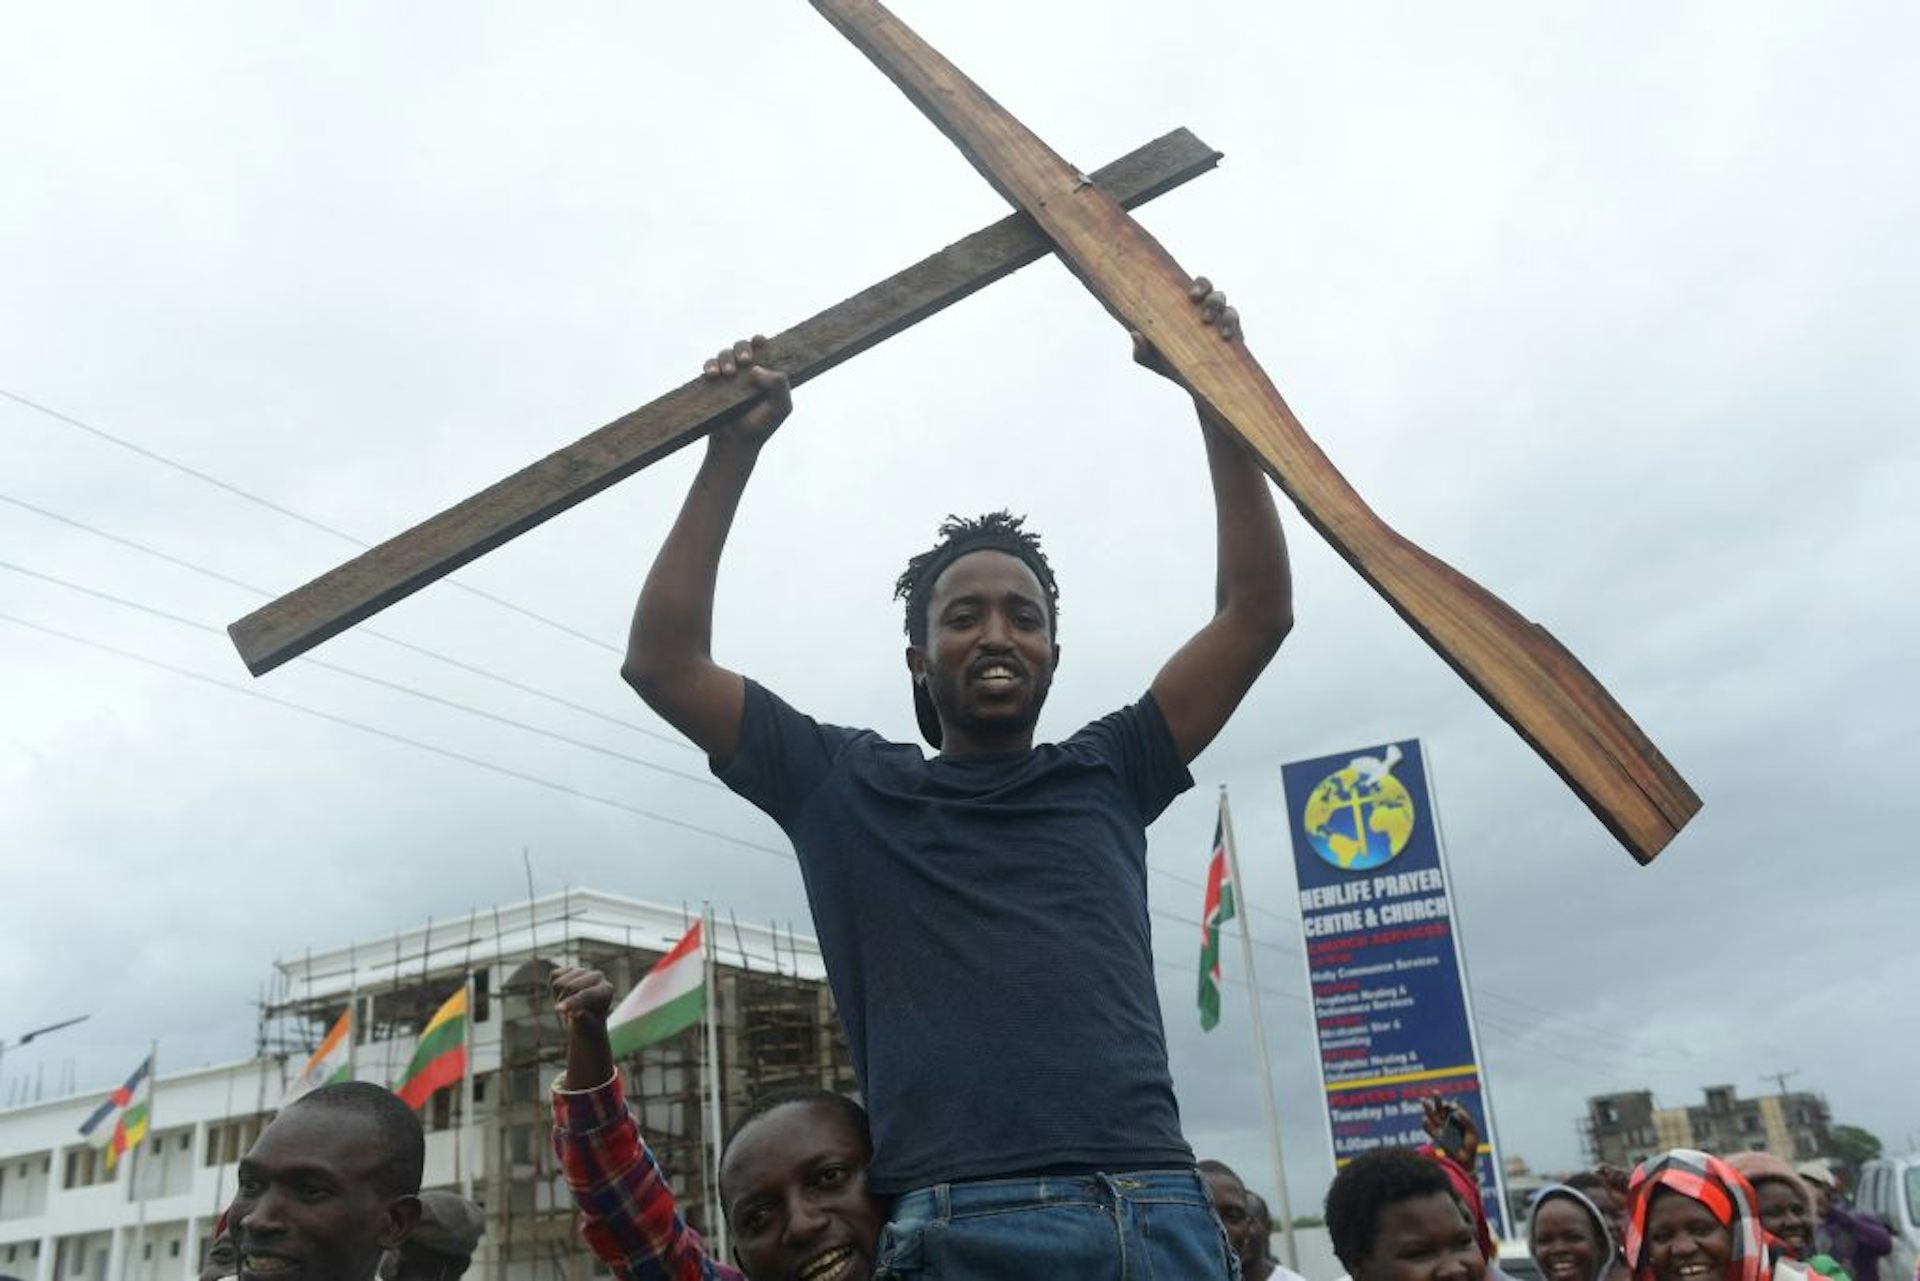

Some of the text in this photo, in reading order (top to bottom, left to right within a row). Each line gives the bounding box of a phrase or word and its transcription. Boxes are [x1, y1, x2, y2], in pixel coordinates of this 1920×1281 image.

[1301, 868, 1442, 911] NEWLIFE PRAYER
[1304, 897, 1448, 937] CENTRE & CHURCH
[1331, 1107, 1382, 1122] Tuesday
[1385, 1104, 1398, 1116] to
